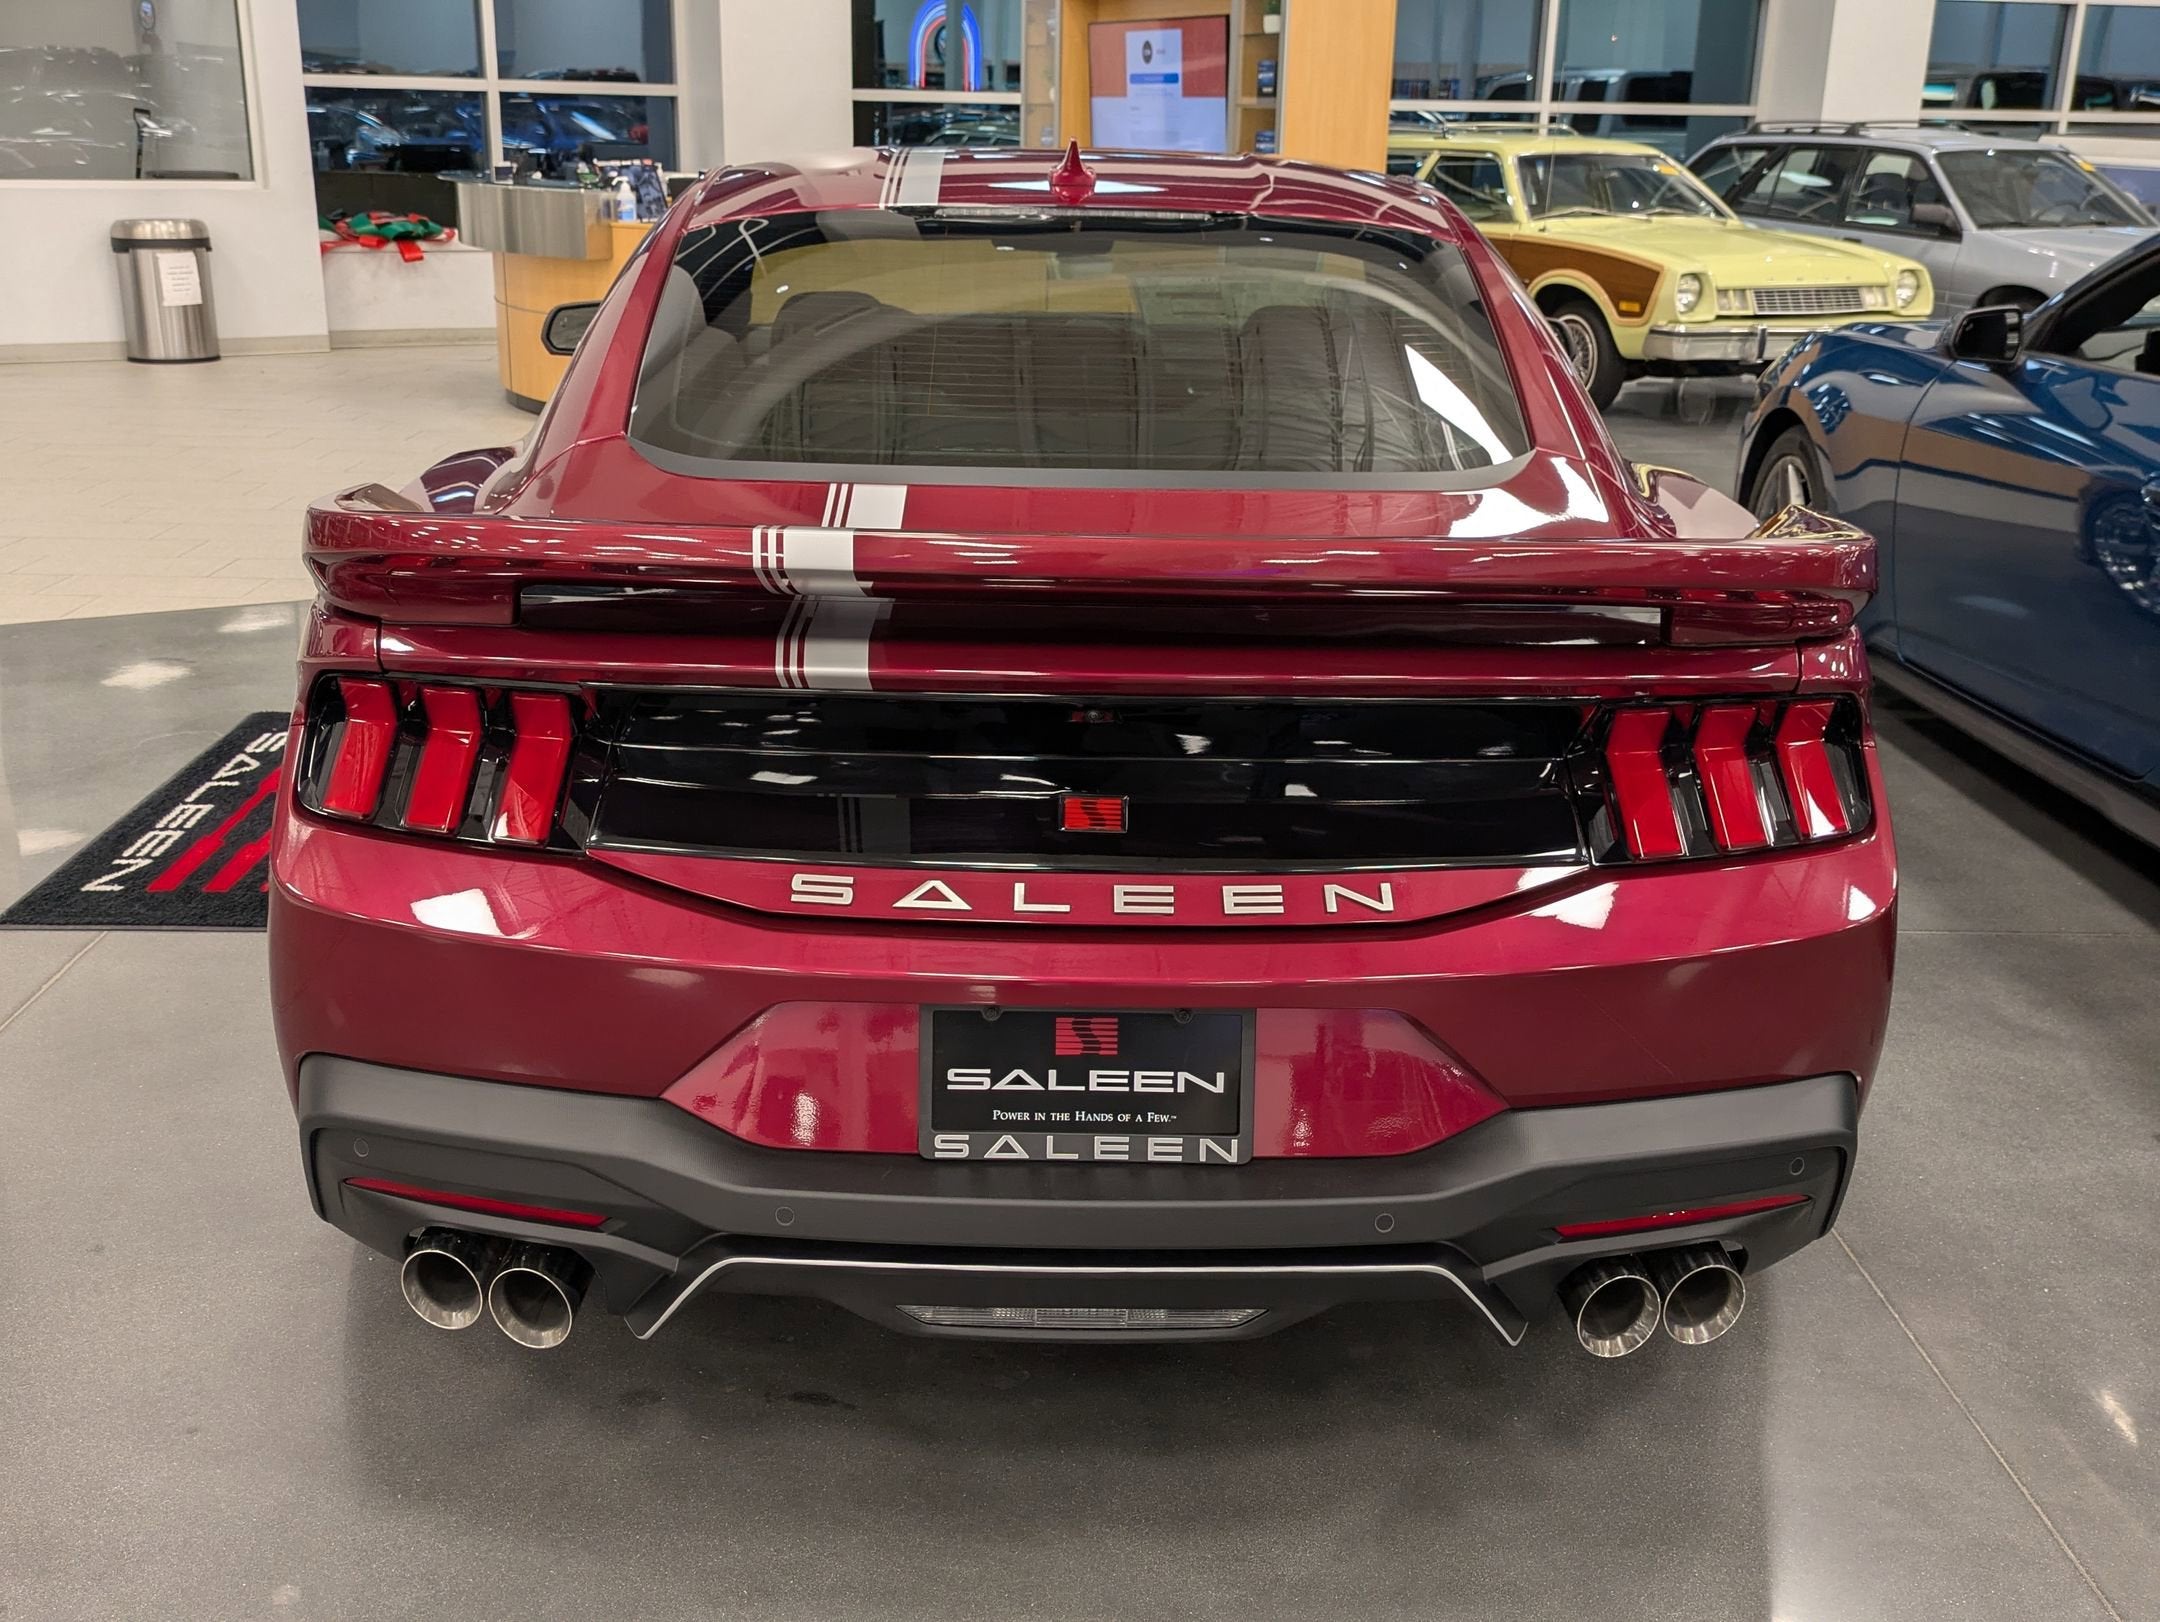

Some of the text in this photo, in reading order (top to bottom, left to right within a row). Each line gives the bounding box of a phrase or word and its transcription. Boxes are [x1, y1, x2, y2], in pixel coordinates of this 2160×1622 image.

[790, 873, 1396, 915] SALEEN
[946, 1068, 1225, 1094] SALEEN
[1034, 1111, 1047, 1122] IN
[1050, 1111, 1071, 1122] THE
[1117, 1112, 1132, 1123] OF
[1135, 1113, 1143, 1123] A
[934, 1134, 1239, 1163] SALEEN
